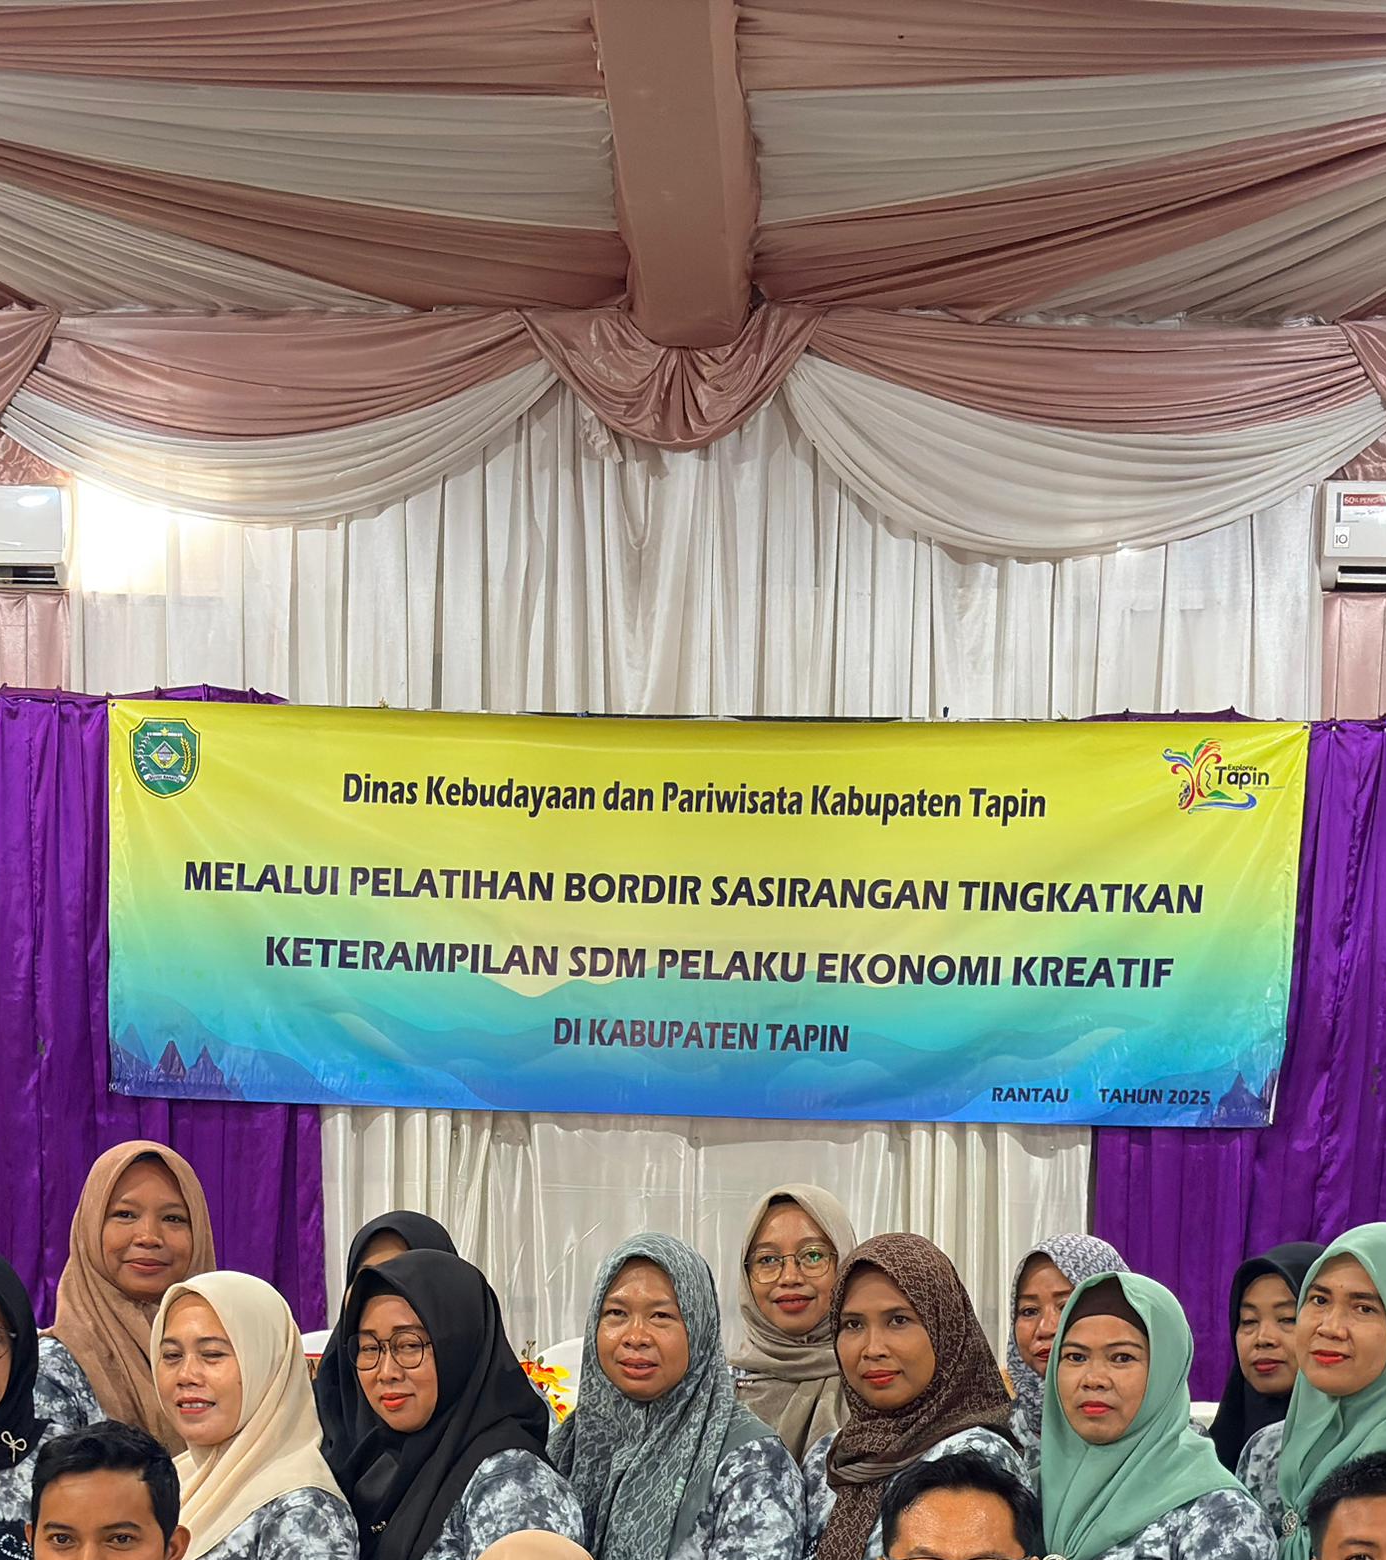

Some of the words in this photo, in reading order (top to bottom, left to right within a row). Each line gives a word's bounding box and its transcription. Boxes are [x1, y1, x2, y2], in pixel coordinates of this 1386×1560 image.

[1214, 766, 1270, 790] Tapin
[343, 773, 418, 805] Dinas
[425, 776, 596, 818] Kebudayaan
[603, 781, 654, 812] dan
[662, 781, 803, 815] Pariwisata
[810, 785, 961, 826] Kabupaten
[969, 787, 1046, 827] Tapin
[184, 861, 339, 896] MELALUI
[349, 866, 554, 902] PELATIHAN
[564, 872, 701, 905] BORDIR
[711, 876, 948, 911] SASIRANGAN
[958, 880, 1203, 914] TINGKATKAN
[265, 936, 558, 976] KETERAMPILAN
[568, 946, 646, 978] SDM
[658, 949, 806, 983] PELAKU
[816, 953, 1001, 986] EKONOMI
[1012, 956, 1174, 988] KREATIF
[553, 1017, 581, 1045] DI
[588, 1018, 758, 1051] KABUPATEN
[766, 1023, 850, 1052] TAPIN
[991, 1086, 1069, 1103] RANTAU
[1098, 1087, 1165, 1105] TAHUN
[1168, 1089, 1211, 1106] 2025
